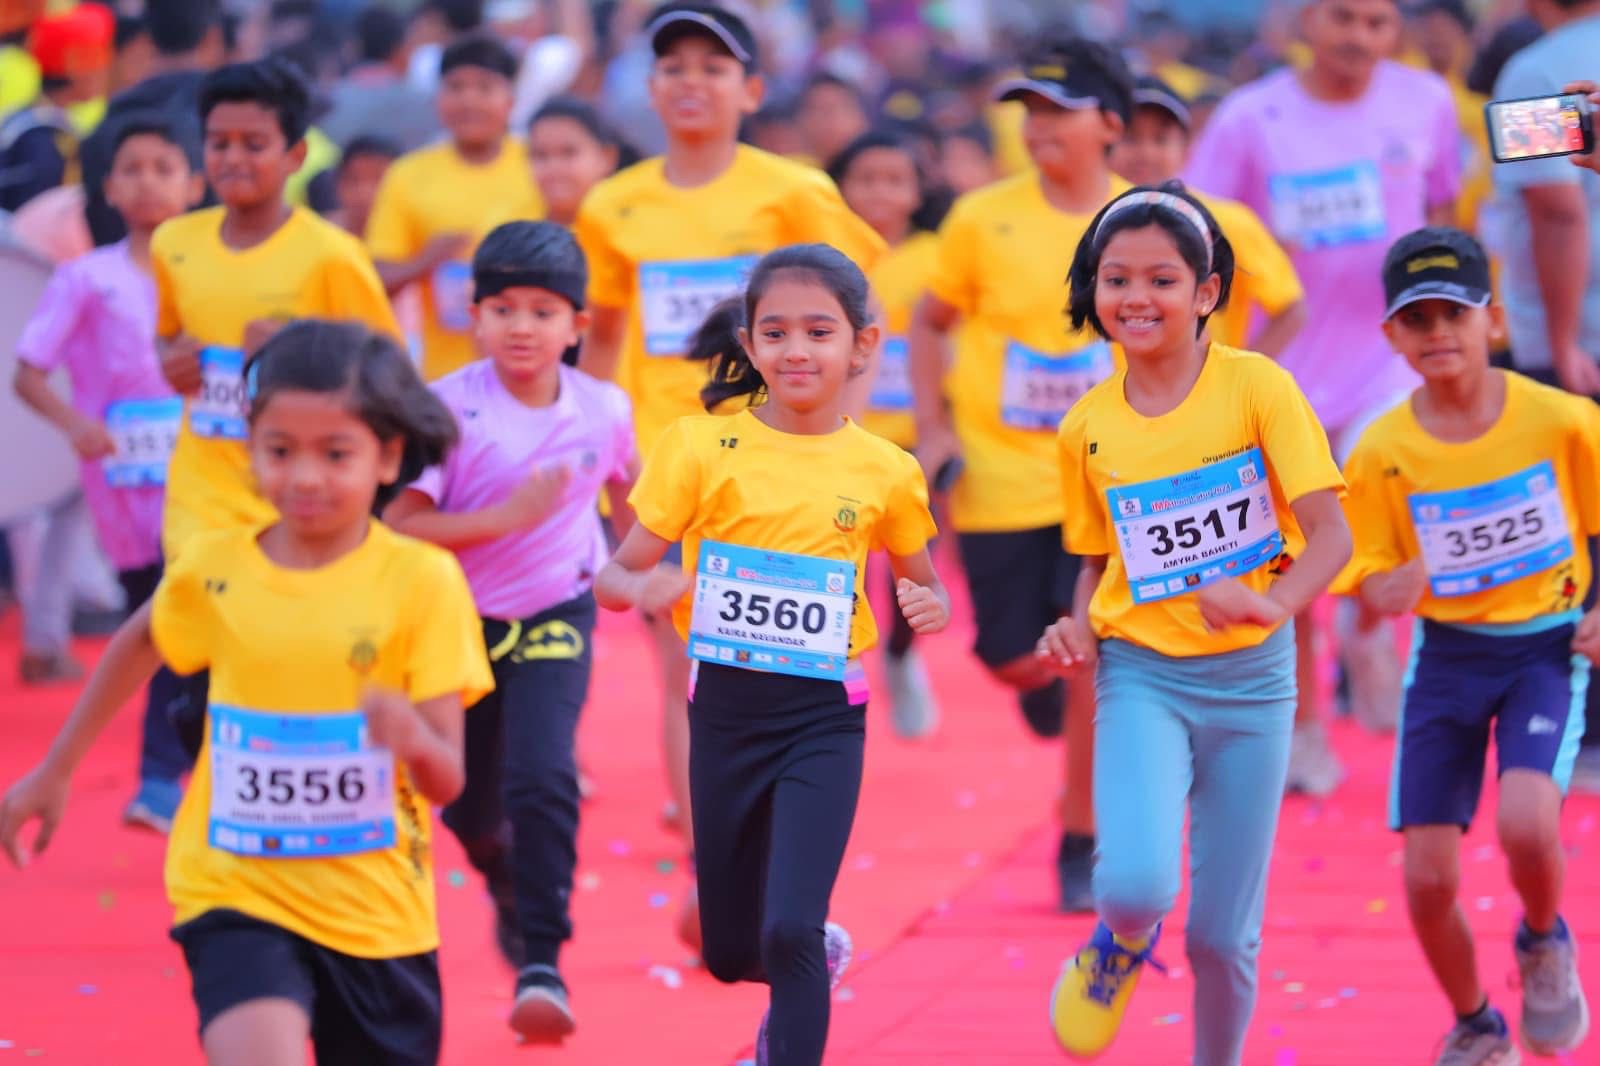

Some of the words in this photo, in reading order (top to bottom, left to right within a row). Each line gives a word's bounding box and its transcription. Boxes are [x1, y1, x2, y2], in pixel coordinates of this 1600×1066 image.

[1146, 497, 1251, 556] 3517
[1446, 507, 1544, 558] 3525
[1163, 555, 1199, 569] AMYRA
[1201, 541, 1238, 558] BAHETI
[719, 590, 827, 634] 3560
[237, 765, 365, 805] 3556
